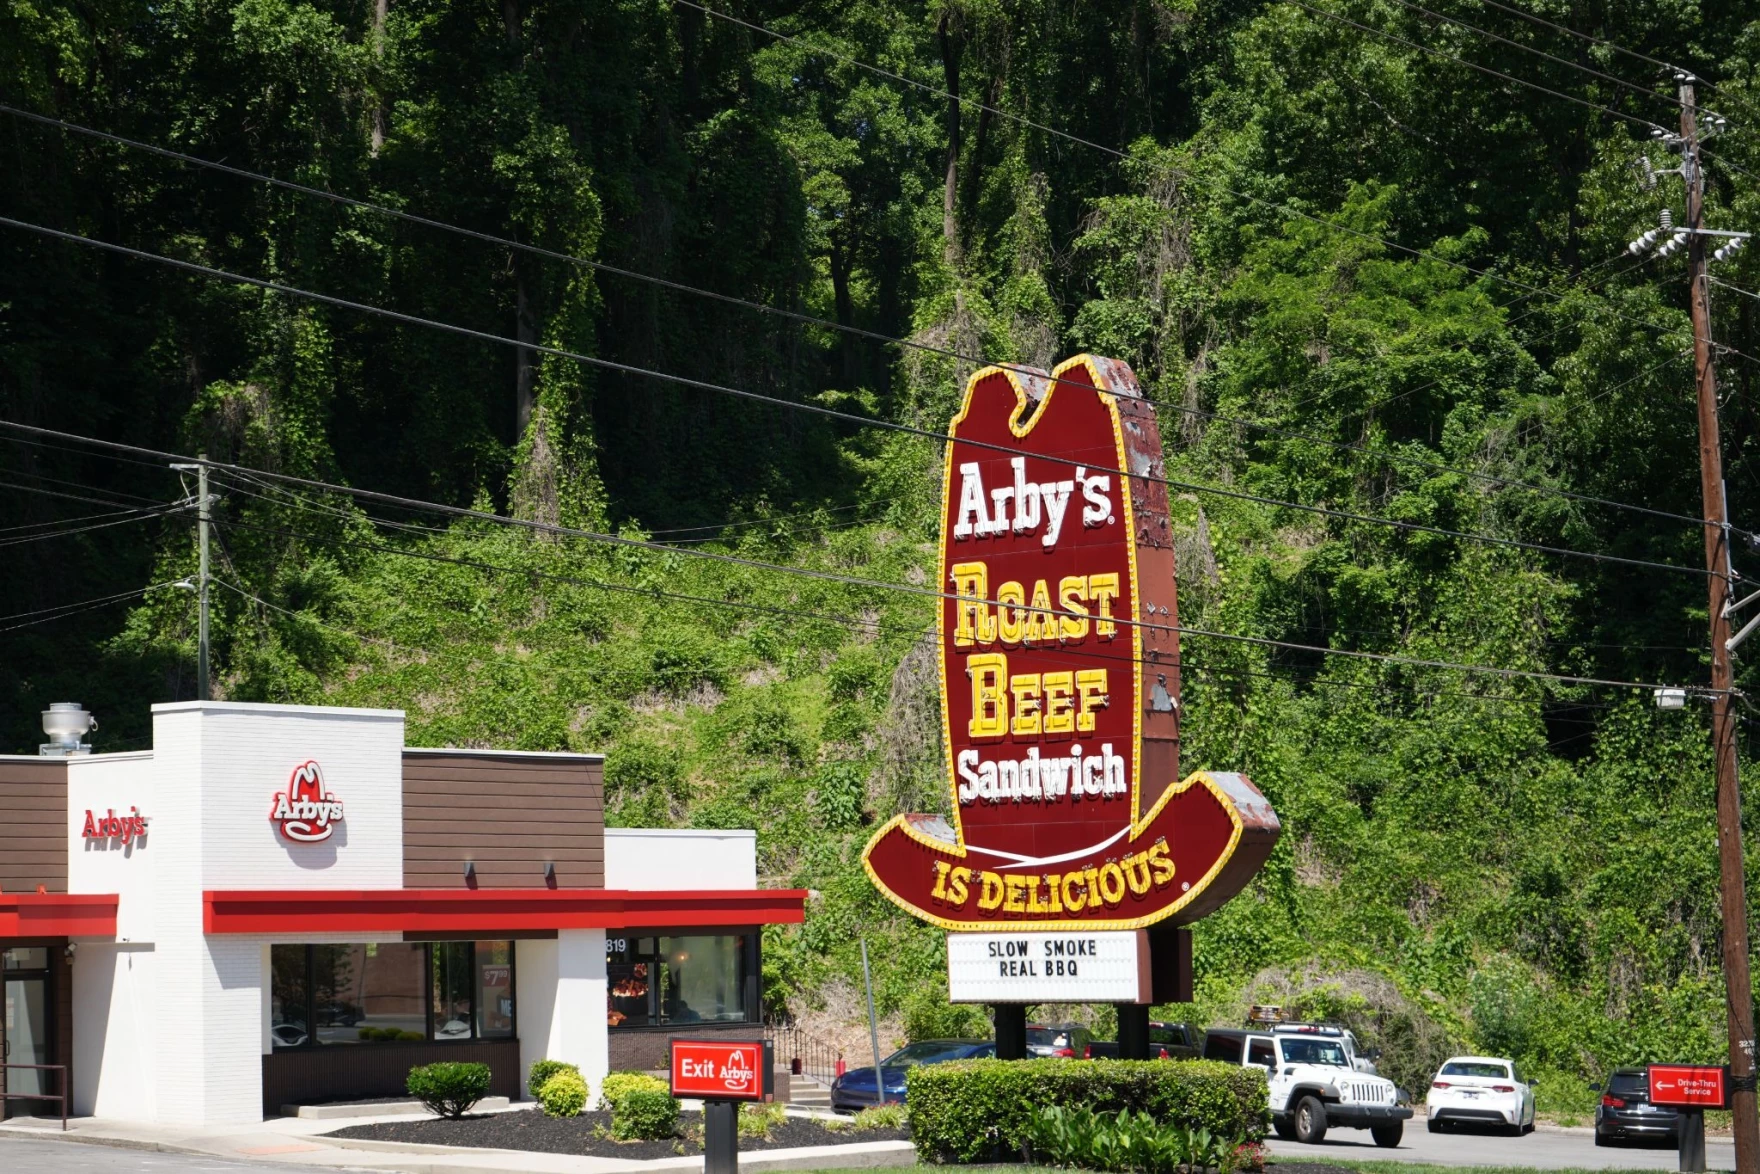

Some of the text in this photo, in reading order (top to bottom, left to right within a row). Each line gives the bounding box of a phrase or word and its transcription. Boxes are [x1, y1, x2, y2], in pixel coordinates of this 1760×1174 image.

[953, 457, 1111, 547] Arby's
[950, 561, 1119, 647] ROAST
[966, 652, 1108, 738] BEEF
[958, 745, 1127, 804] Sandwich
[82, 806, 146, 845] Arby's
[274, 794, 343, 826] Arby's
[931, 840, 1176, 914] IS DELICIOUS
[988, 940, 1097, 957] SLOW SMOKE
[999, 960, 1078, 977] REAL BBQ
[681, 1058, 715, 1079] Exit
[719, 1065, 753, 1082] Arby's
[1677, 1079, 1717, 1088] Drive-Thru
[1683, 1087, 1711, 1096] Service
